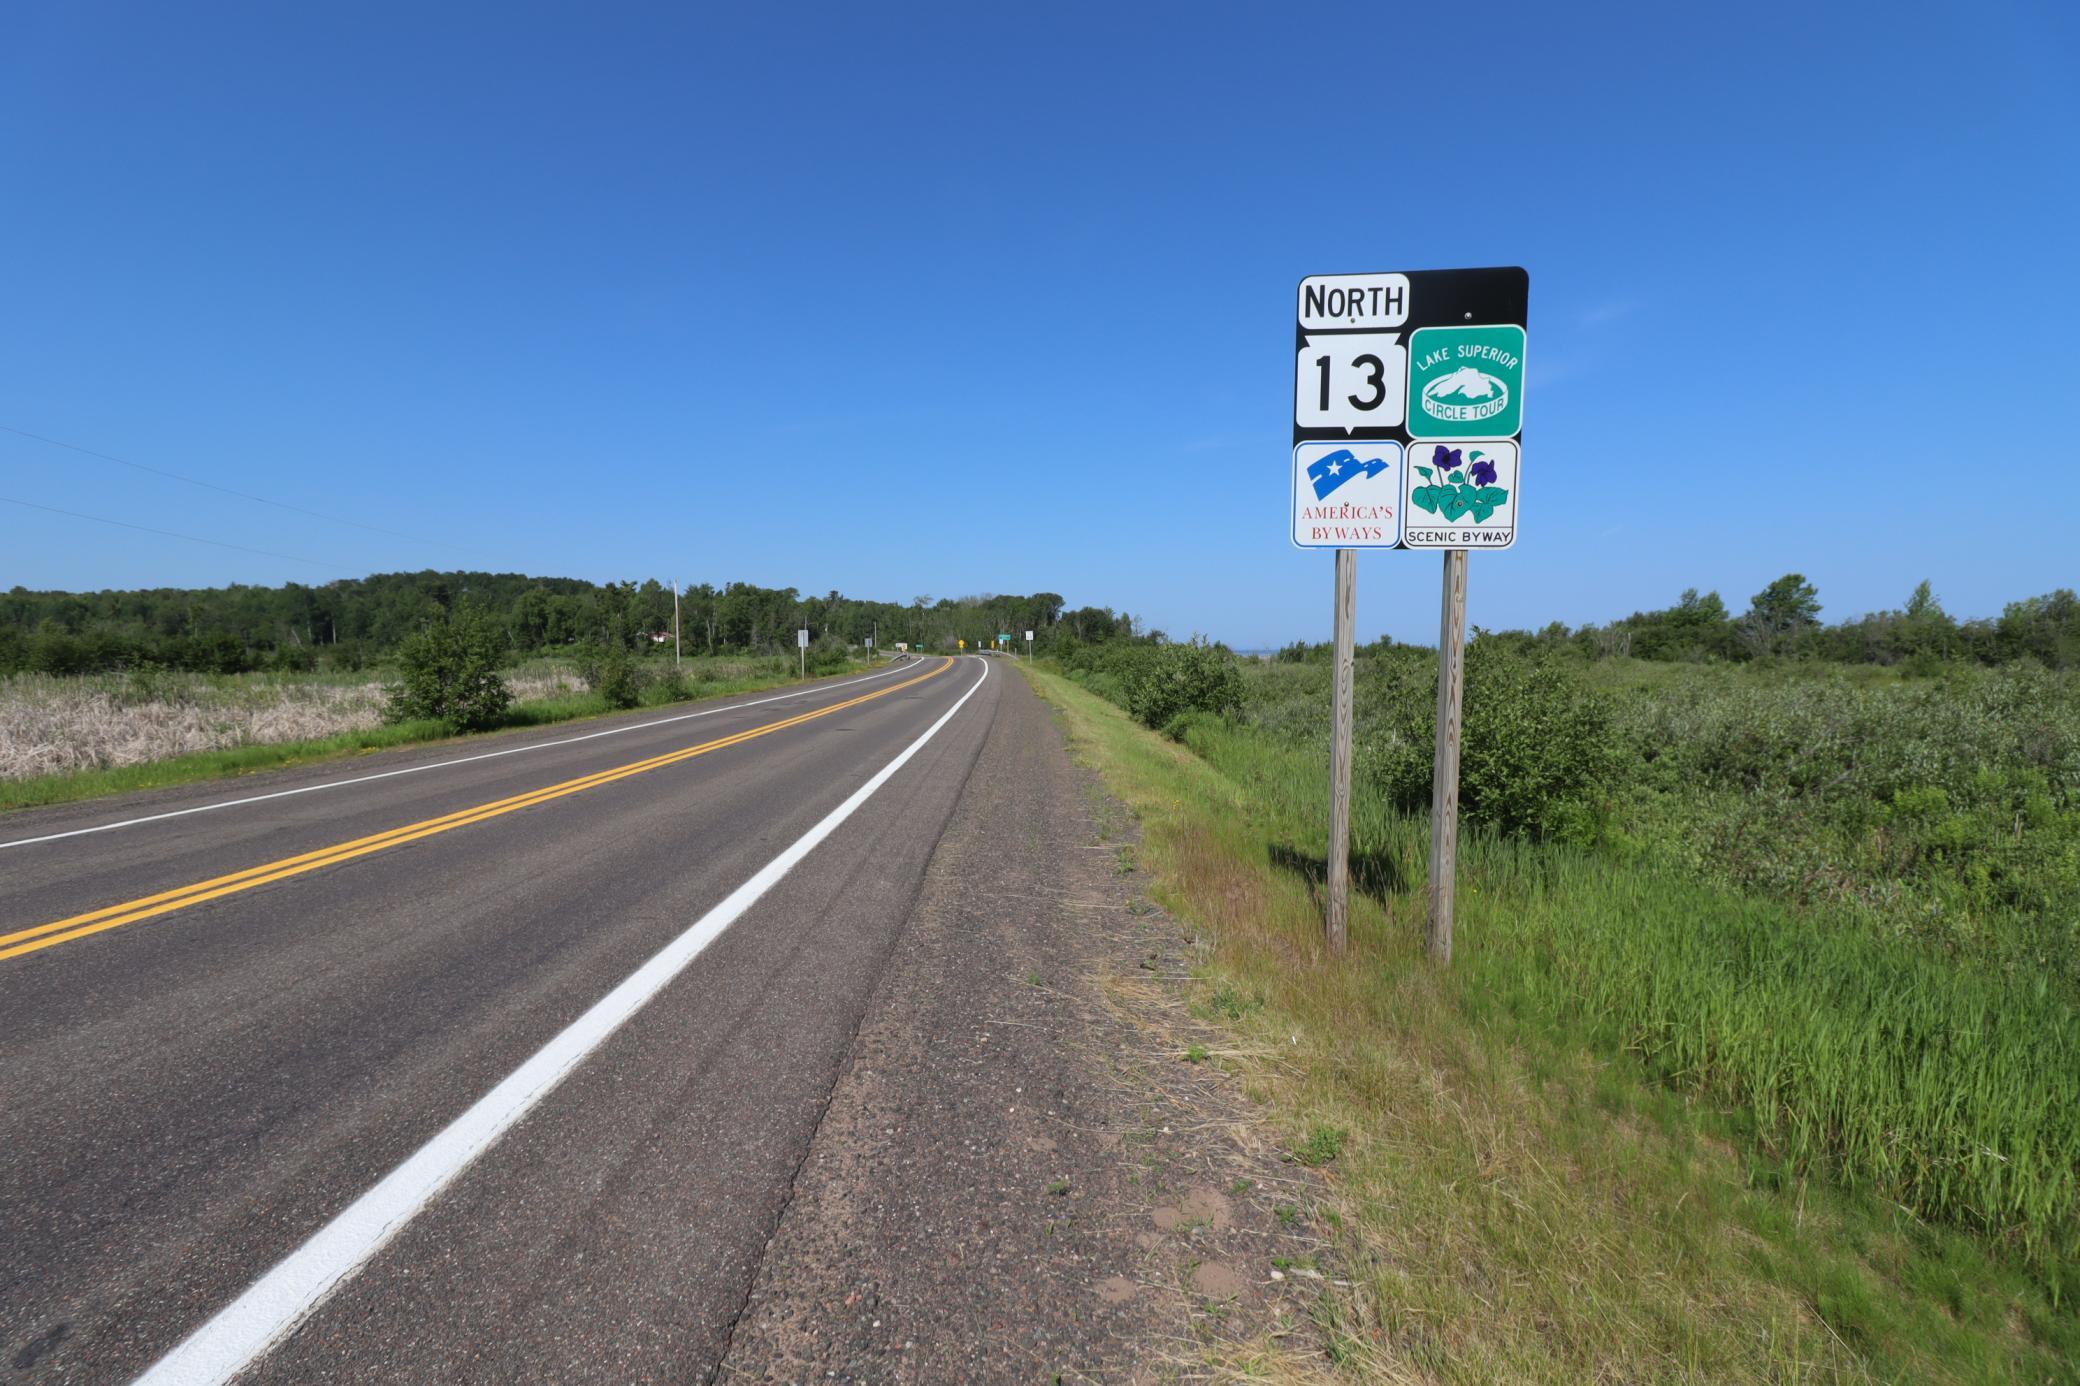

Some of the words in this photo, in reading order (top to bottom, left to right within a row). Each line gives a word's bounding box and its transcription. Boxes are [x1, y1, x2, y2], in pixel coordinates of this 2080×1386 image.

[1304, 284, 1403, 318] NORTH
[1416, 347, 1450, 371] LAKE
[1457, 344, 1519, 370] SUPERIOR
[1316, 353, 1387, 411] 13
[1424, 398, 1467, 420] CIRCLE
[1473, 398, 1504, 419] TOUR
[1311, 526, 1382, 540] BYWAYS
[1408, 531, 1456, 542] SCENIC
[1462, 531, 1511, 543] BYWAY
